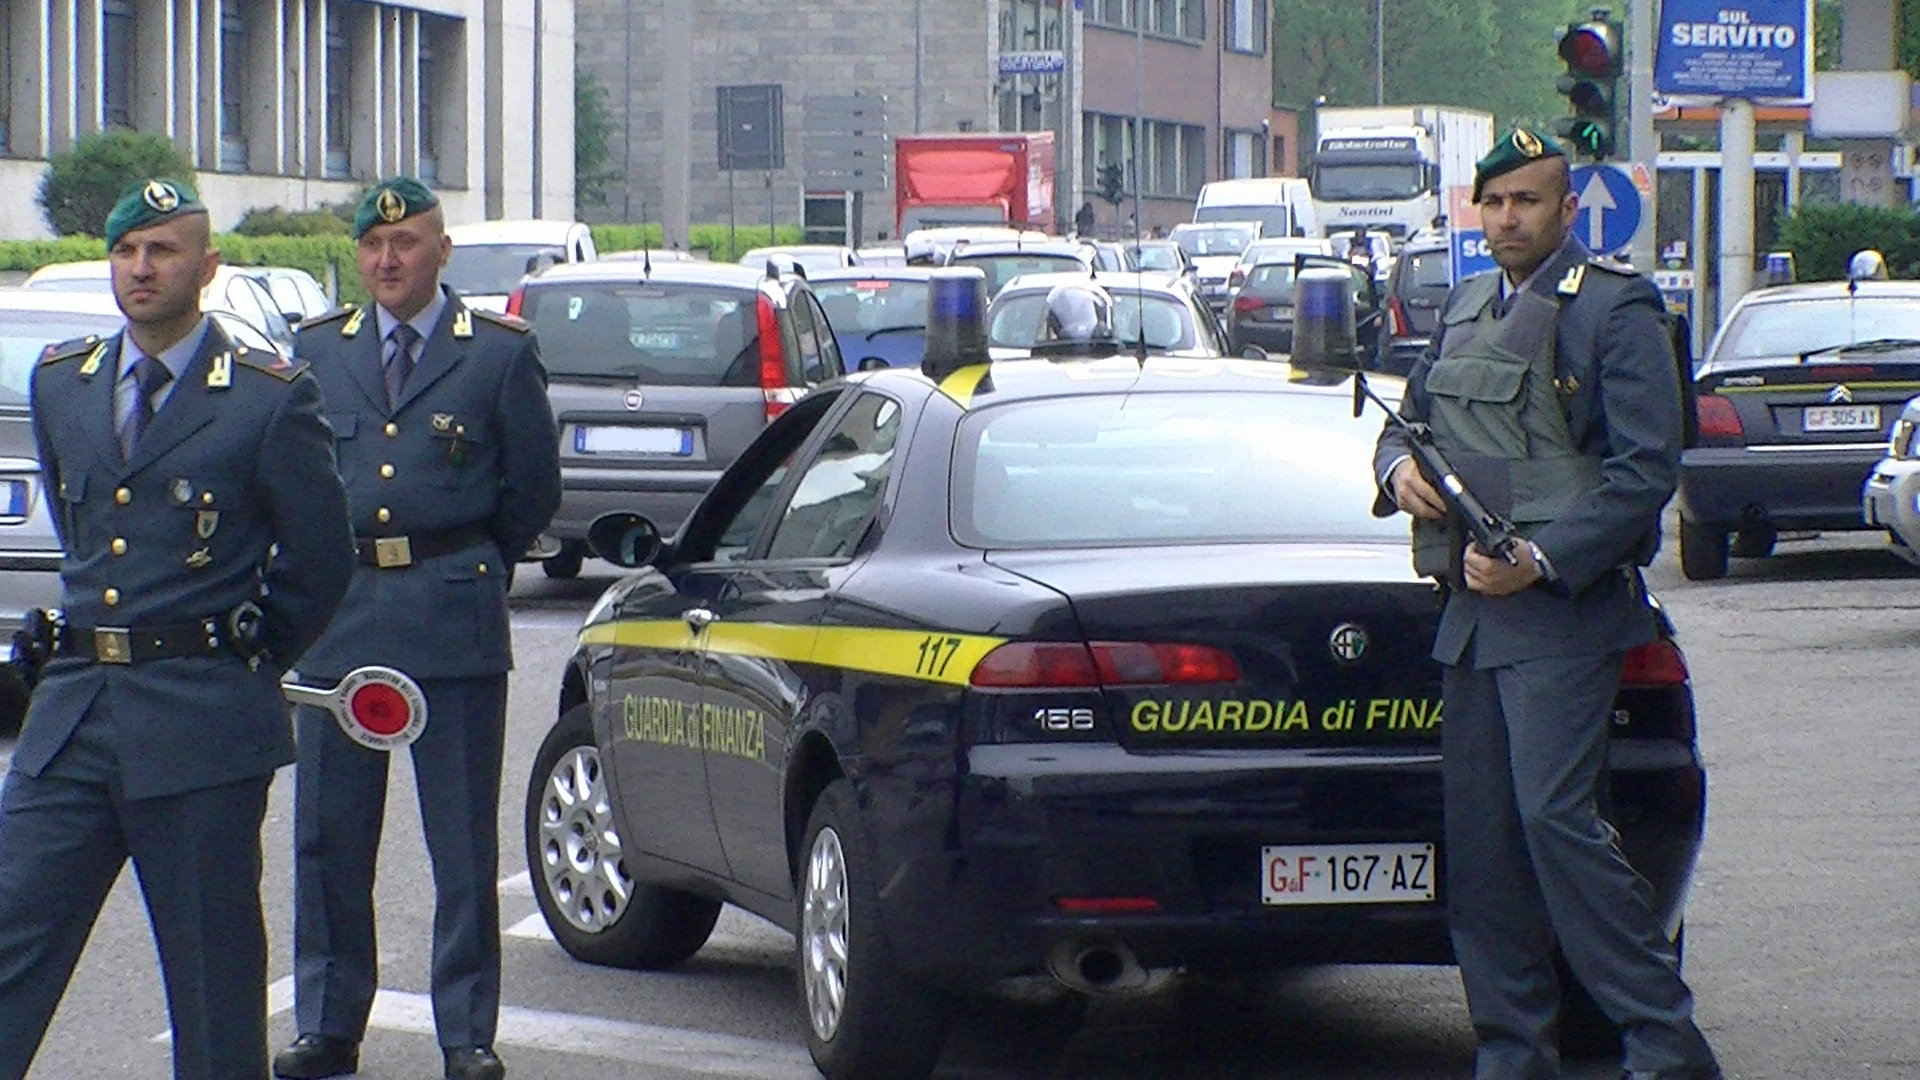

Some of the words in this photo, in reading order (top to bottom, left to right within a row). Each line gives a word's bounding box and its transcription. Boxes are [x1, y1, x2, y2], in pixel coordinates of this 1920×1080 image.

[1718, 10, 1750, 24] SUL
[1672, 23, 1796, 49] SERVITO
[916, 635, 961, 677] 117
[624, 694, 684, 746] GUARDIA
[687, 703, 700, 749] di
[702, 704, 766, 761] FINANZA
[1034, 709, 1094, 730] 156
[1130, 699, 1309, 732] GUARDIA
[1321, 699, 1356, 731] di
[1391, 853, 1429, 891] AZ
